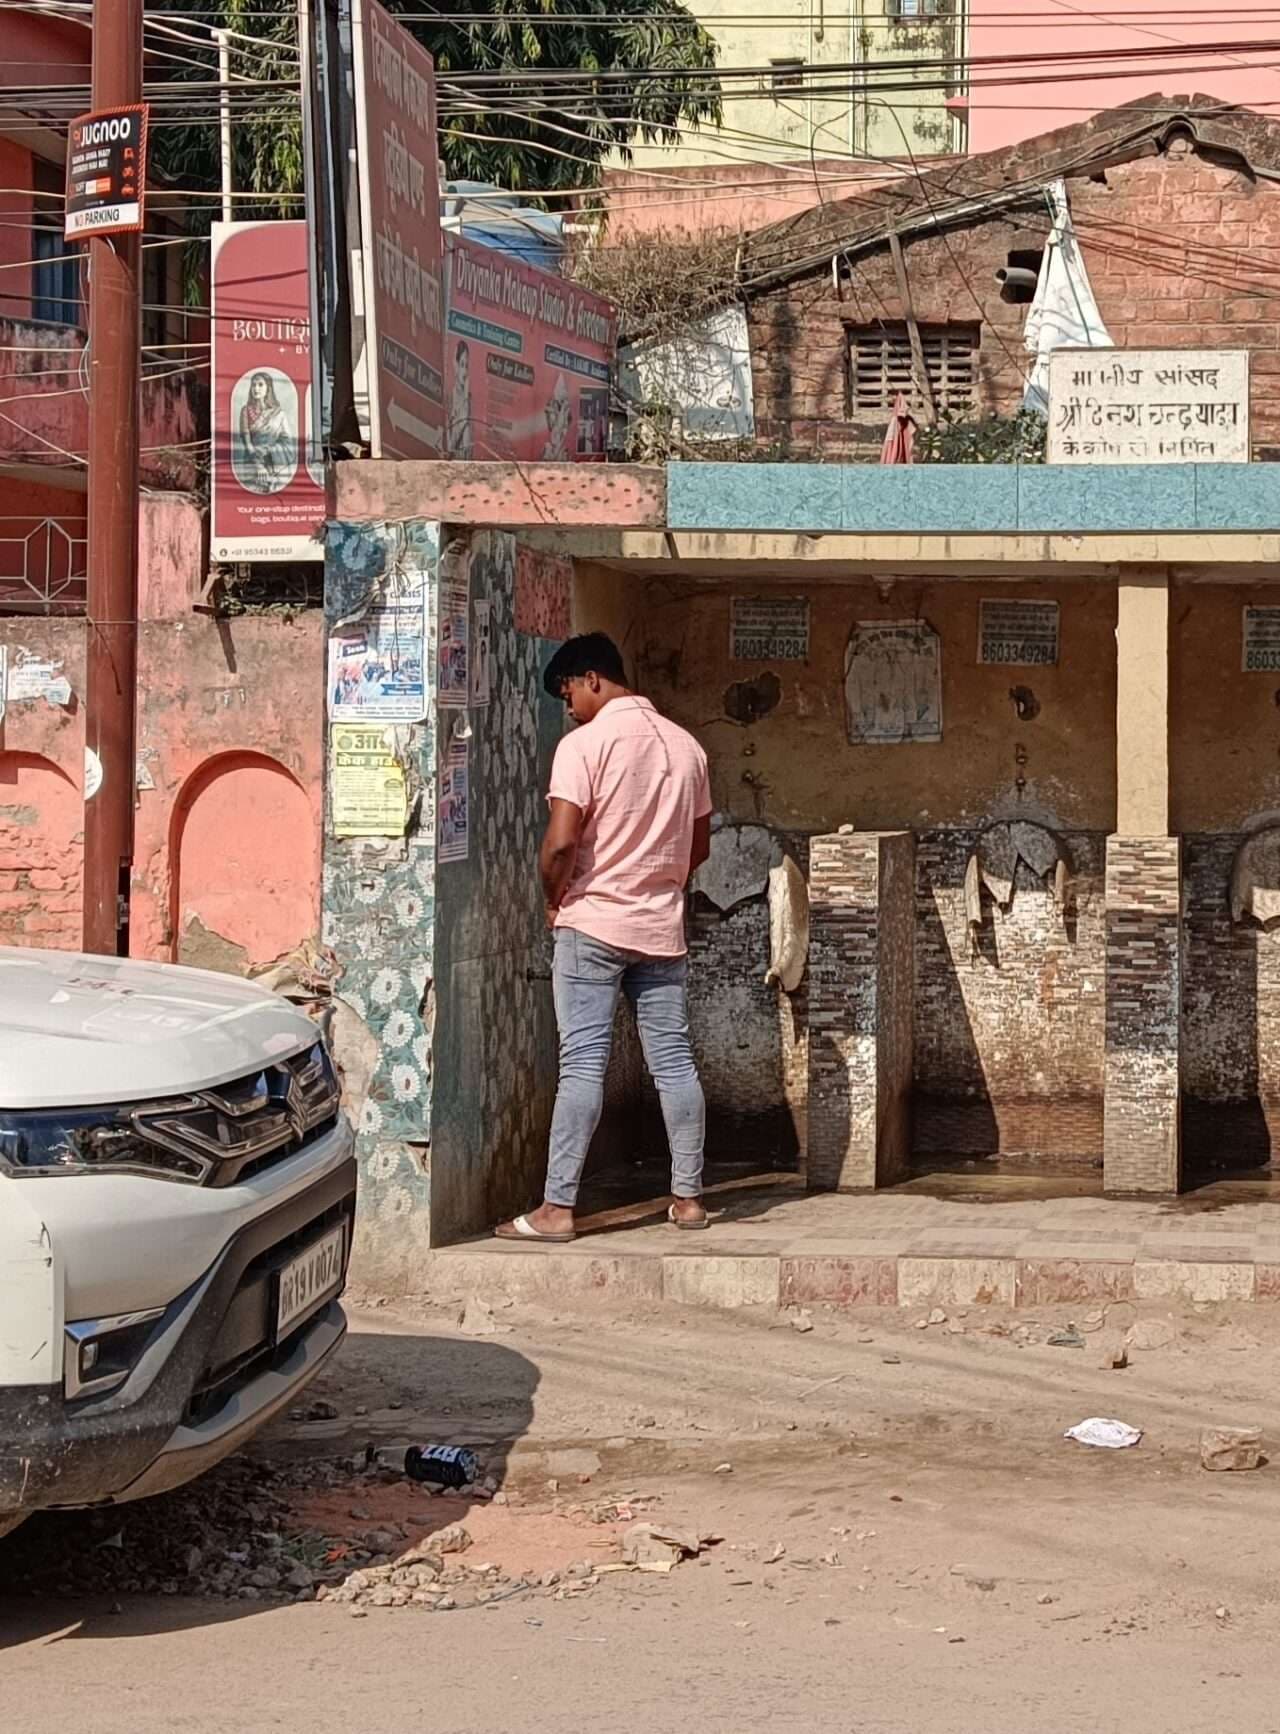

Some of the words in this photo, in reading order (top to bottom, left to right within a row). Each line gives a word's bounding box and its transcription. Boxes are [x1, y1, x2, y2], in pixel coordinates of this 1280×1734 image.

[81, 118, 131, 147] JUGNOO
[75, 214, 84, 227] NO
[85, 208, 120, 224] PARKING
[456, 248, 501, 304] Divyanka
[503, 267, 538, 328] Makeup
[539, 283, 565, 328] Studio
[567, 292, 574, 331] &
[233, 318, 310, 342] BOUTIQ
[488, 356, 502, 372] Only
